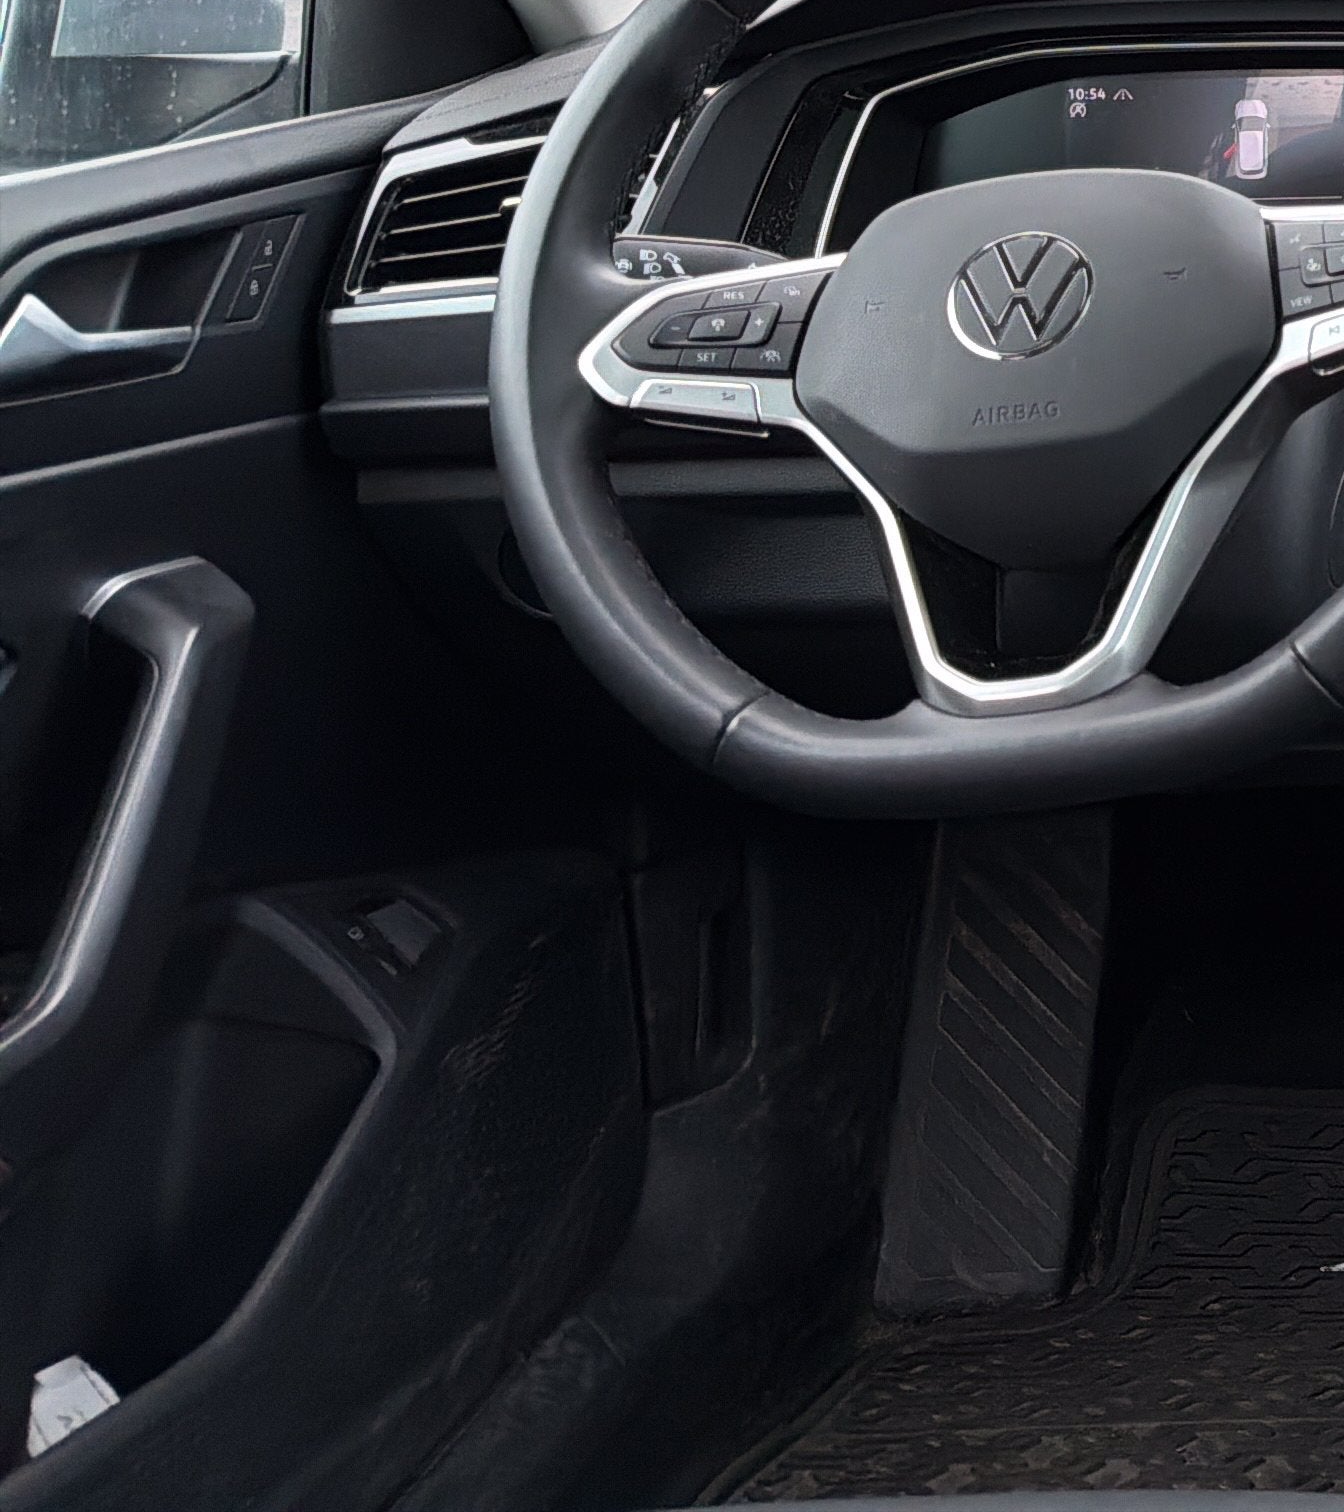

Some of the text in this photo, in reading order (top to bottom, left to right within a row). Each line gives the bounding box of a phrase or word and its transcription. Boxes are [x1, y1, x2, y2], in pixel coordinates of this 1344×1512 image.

[1068, 87, 1106, 100] 10:54
[722, 291, 745, 300] RES
[696, 352, 717, 362] SET
[971, 400, 1060, 427] AIRBAG
